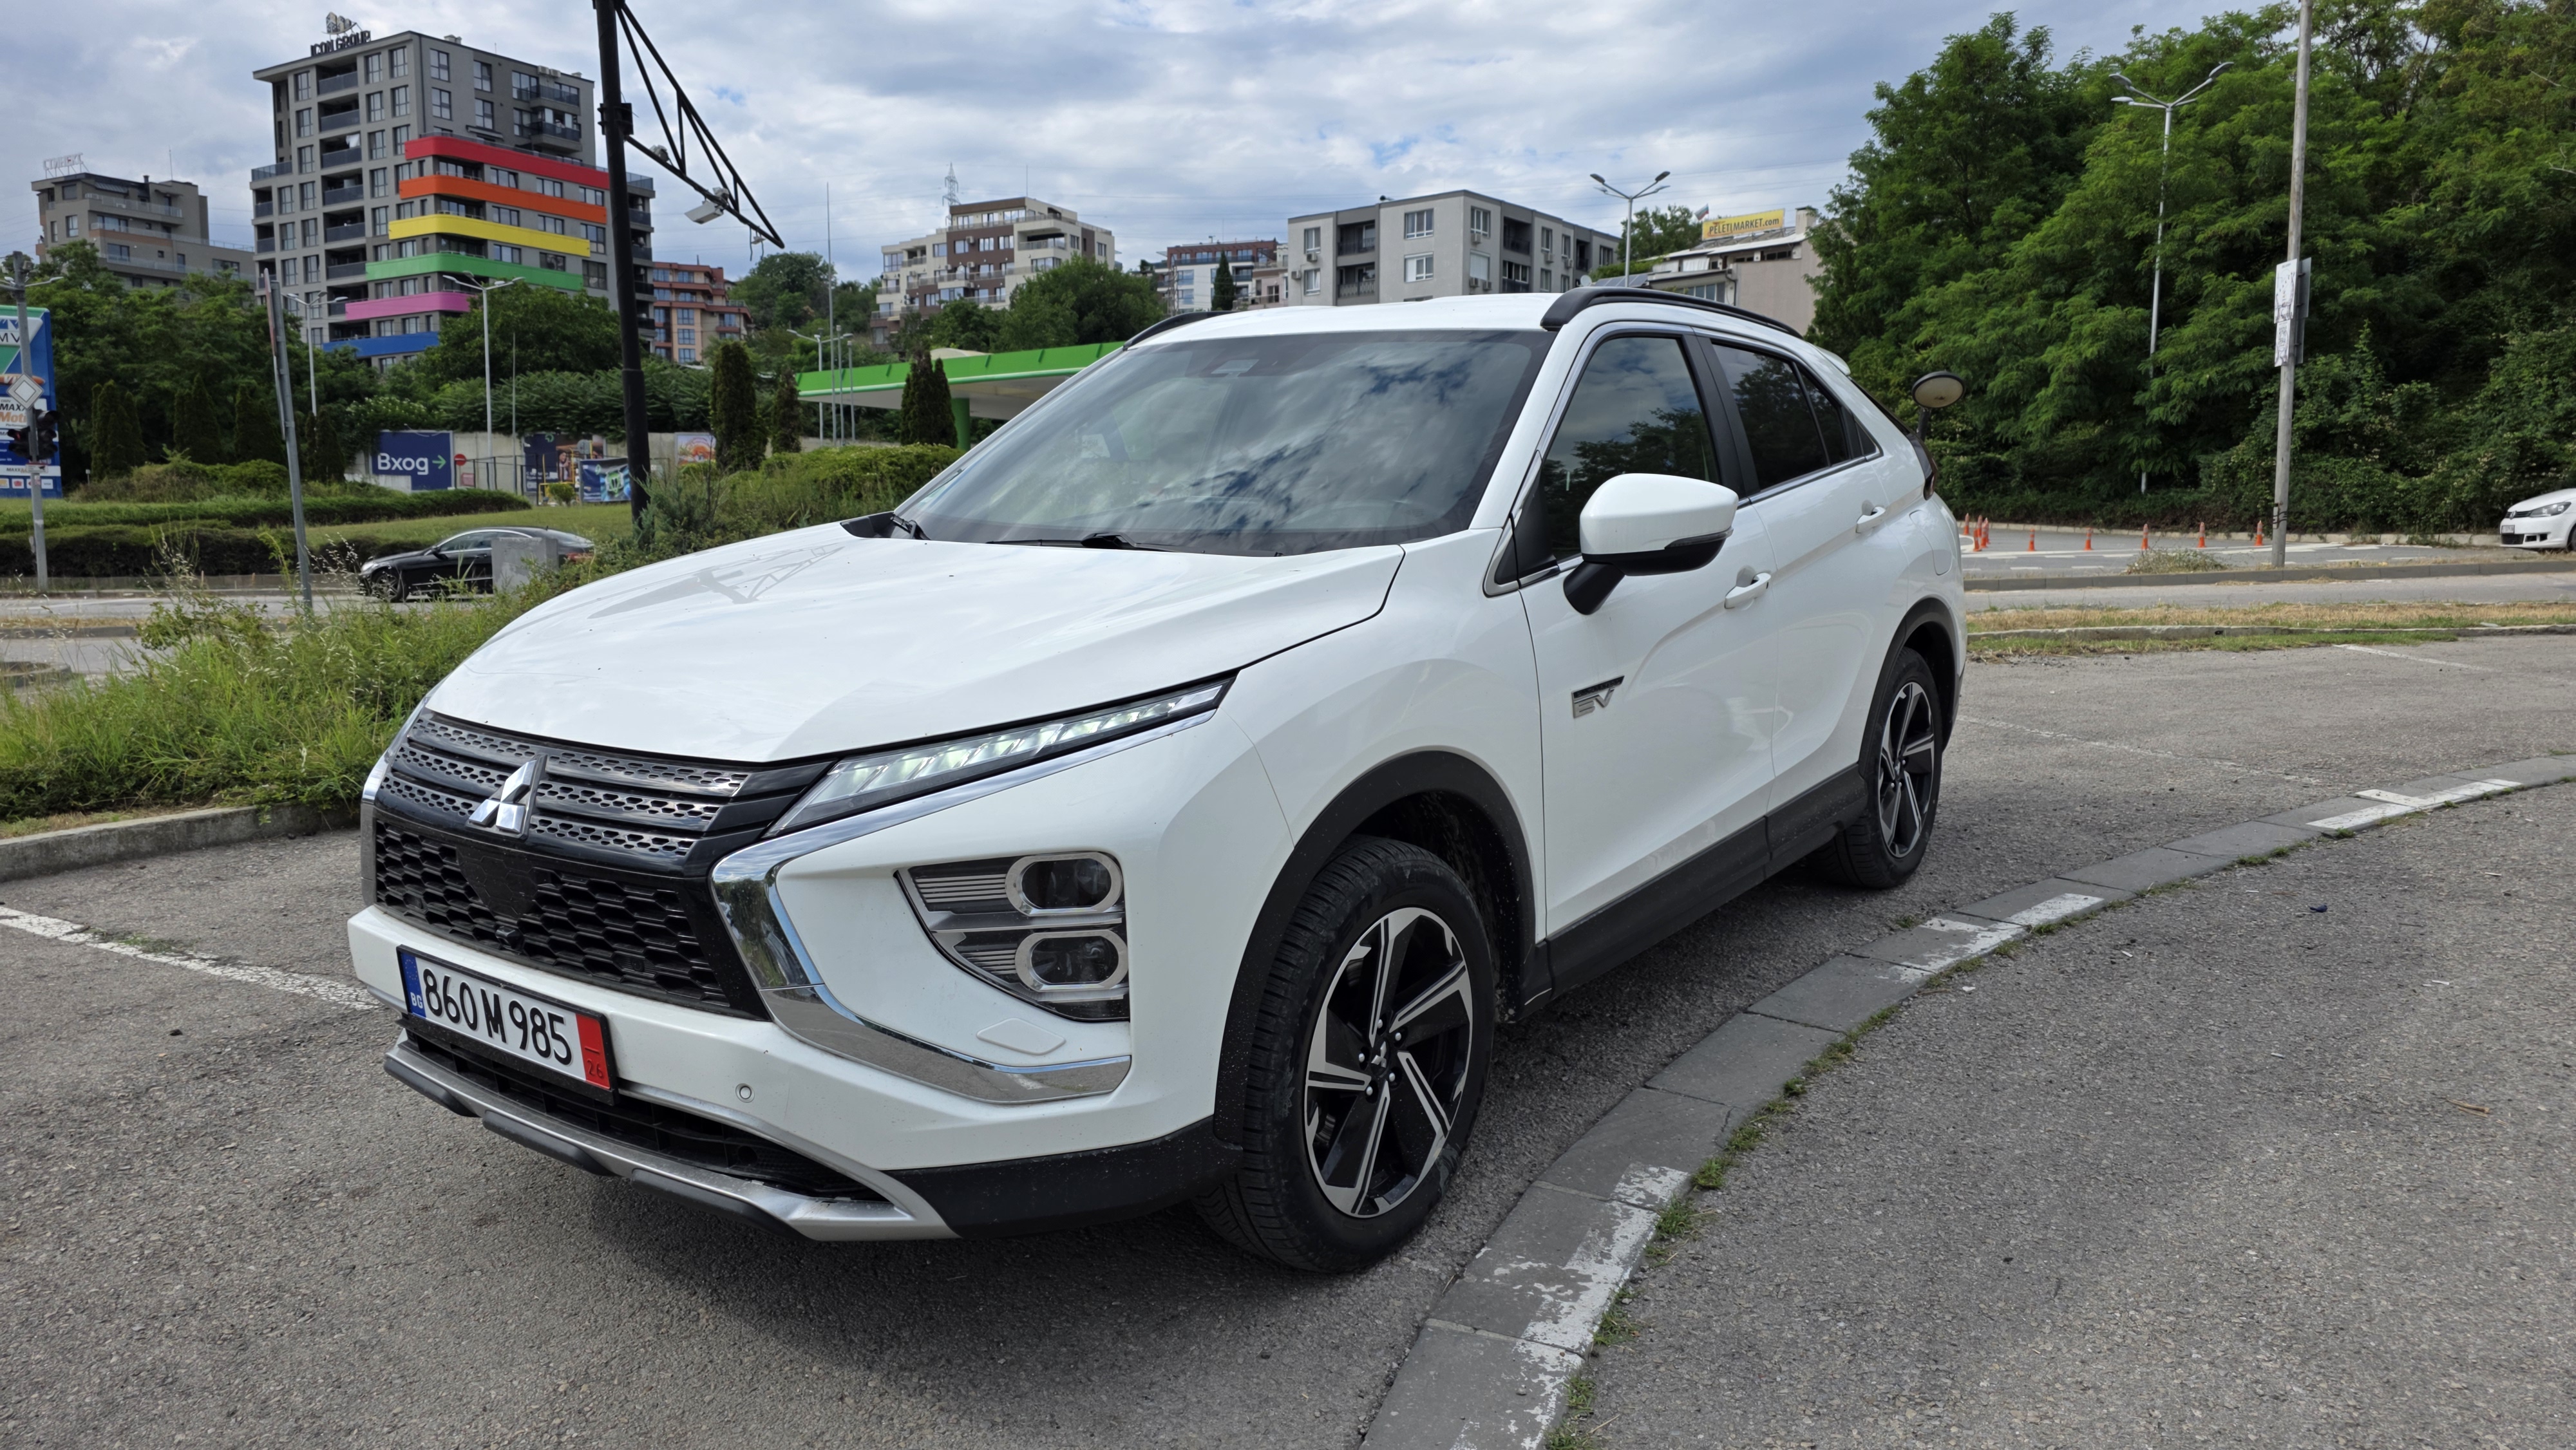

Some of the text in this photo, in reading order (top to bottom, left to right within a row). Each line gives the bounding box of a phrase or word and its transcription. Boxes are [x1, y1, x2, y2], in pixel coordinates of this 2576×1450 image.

[310, 30, 371, 57] ICON GROUP
[410, 992, 423, 1009] BG
[587, 1059, 603, 1078] 26
